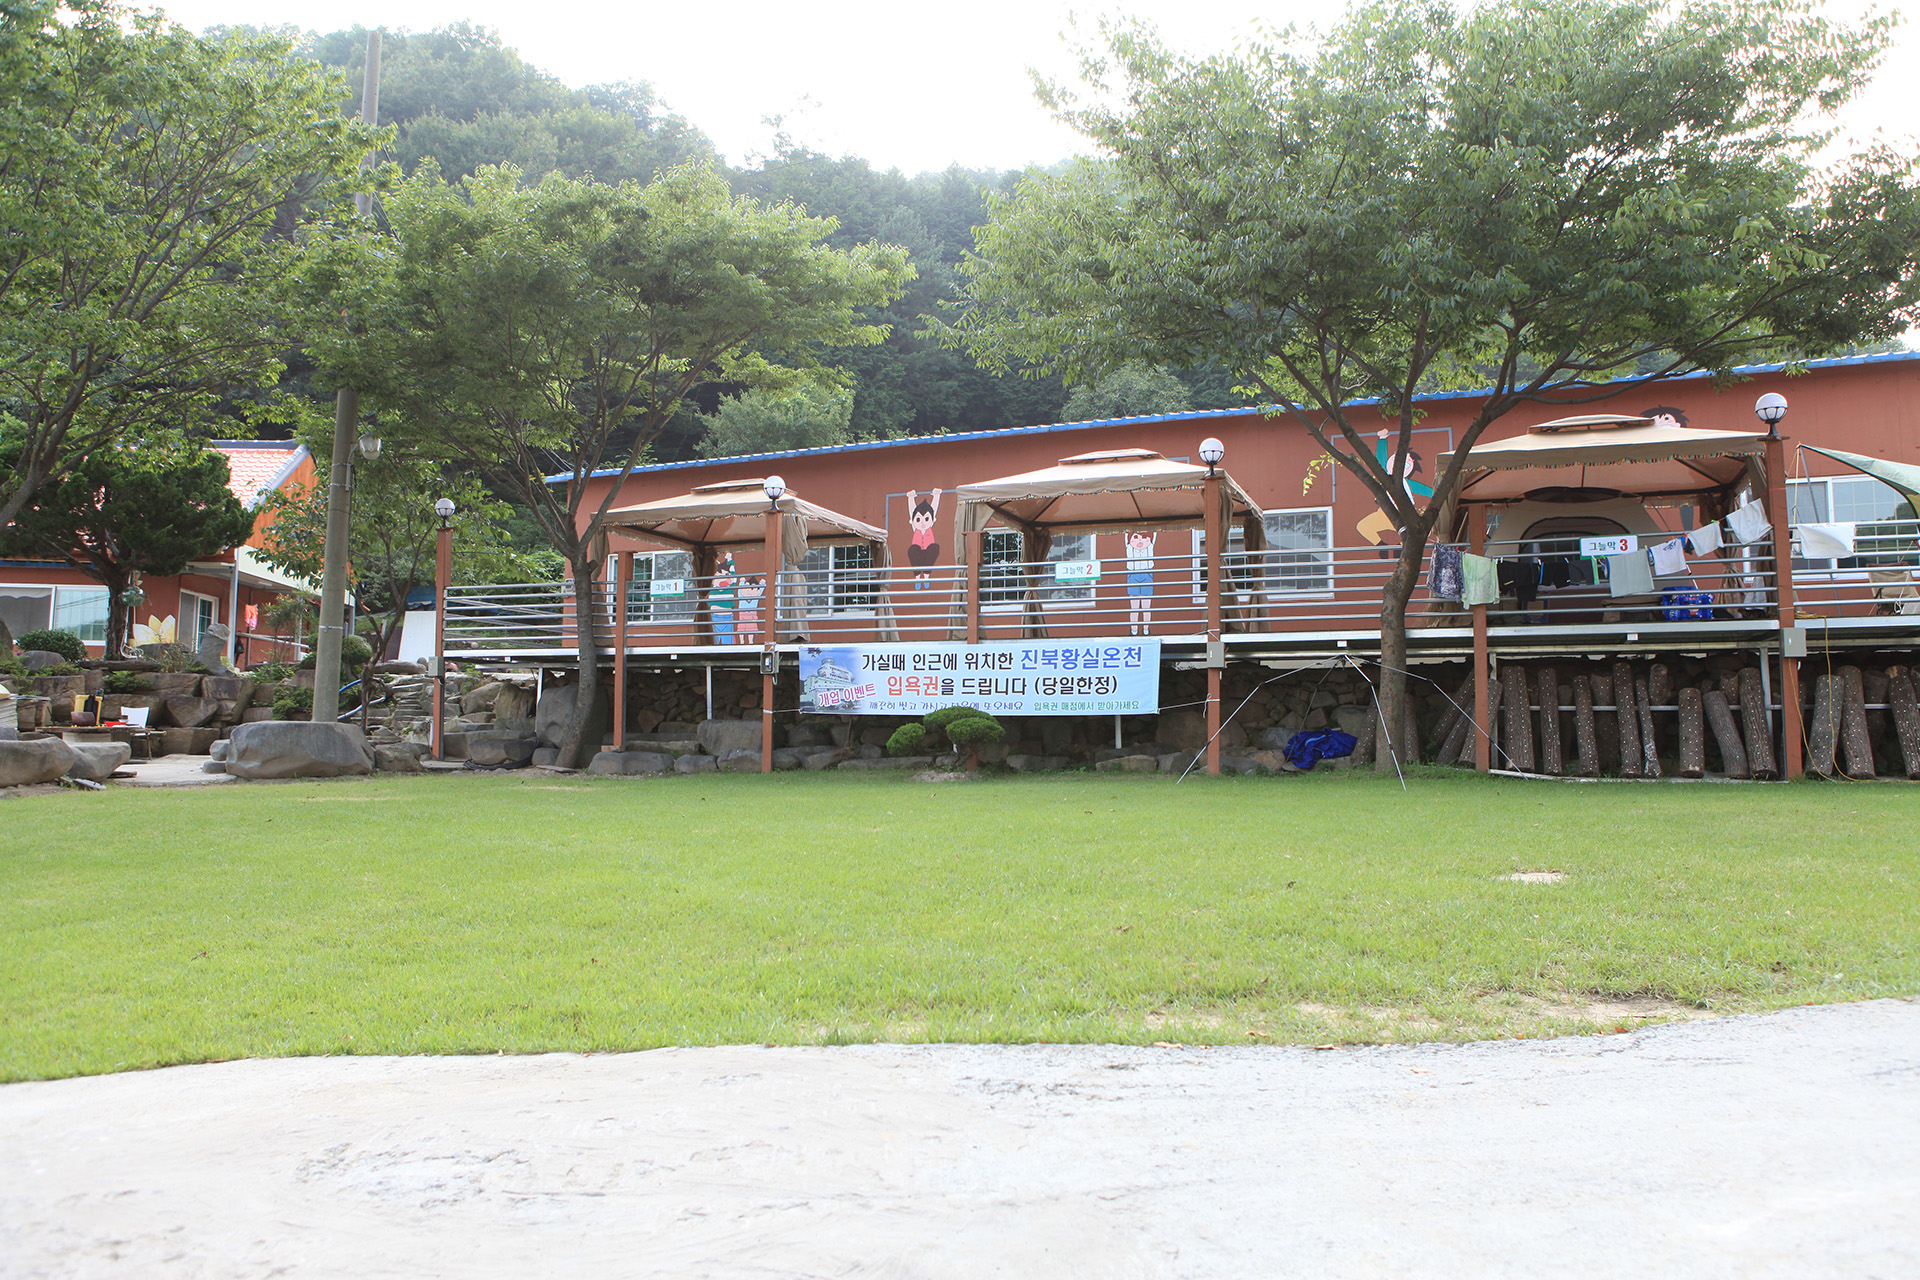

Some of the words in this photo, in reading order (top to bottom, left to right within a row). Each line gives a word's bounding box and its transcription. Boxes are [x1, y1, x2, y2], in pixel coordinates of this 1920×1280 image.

[1589, 542, 1616, 550] 그늘막
[1620, 539, 1628, 551] 3
[1086, 564, 1093, 574] 2
[674, 582, 678, 591] 1
[862, 654, 906, 671] 가실때
[912, 653, 957, 670] 인근에
[964, 652, 1013, 670] 위치한
[1020, 646, 1142, 670] 진북황실온천
[888, 676, 954, 696] 입욕권을
[961, 677, 1026, 696] 드립니다
[1034, 676, 1118, 696] (당일한정)
[818, 690, 840, 705] 개업
[844, 683, 876, 700] 이벤트
[1034, 702, 1058, 711] 입욕권
[1061, 701, 1094, 711] 매점에서
[1097, 700, 1139, 711] 받아가세요
